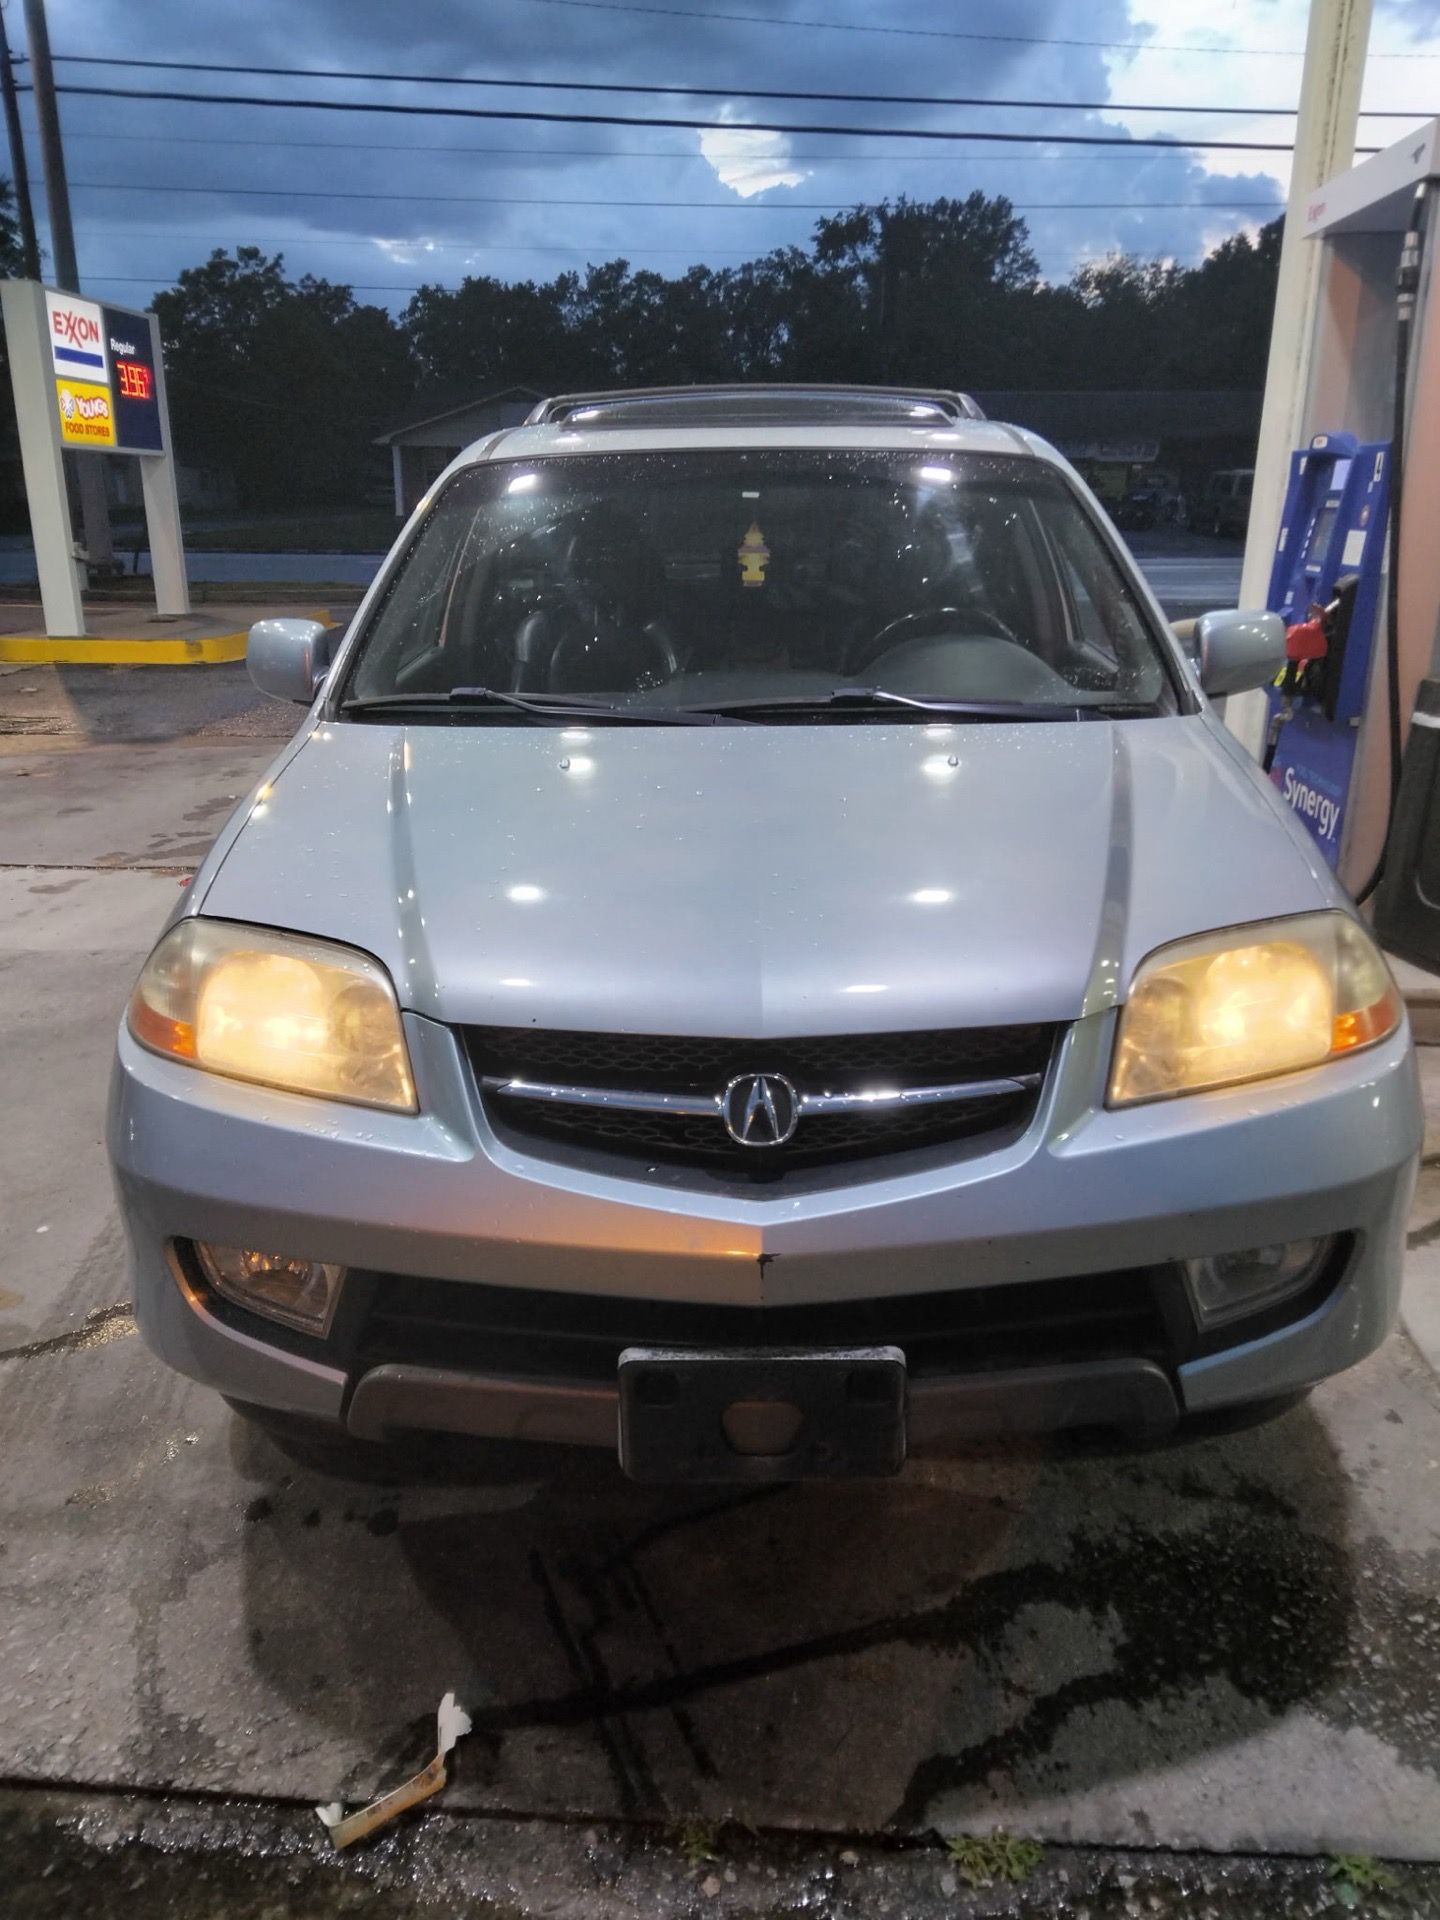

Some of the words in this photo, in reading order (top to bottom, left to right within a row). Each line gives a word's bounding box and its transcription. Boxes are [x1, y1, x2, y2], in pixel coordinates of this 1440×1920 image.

[52, 311, 100, 348] EXXON
[110, 338, 135, 355] Regular
[65, 422, 84, 434] FOOD
[85, 423, 110, 437] STORES
[1284, 767, 1340, 840] Synergy
